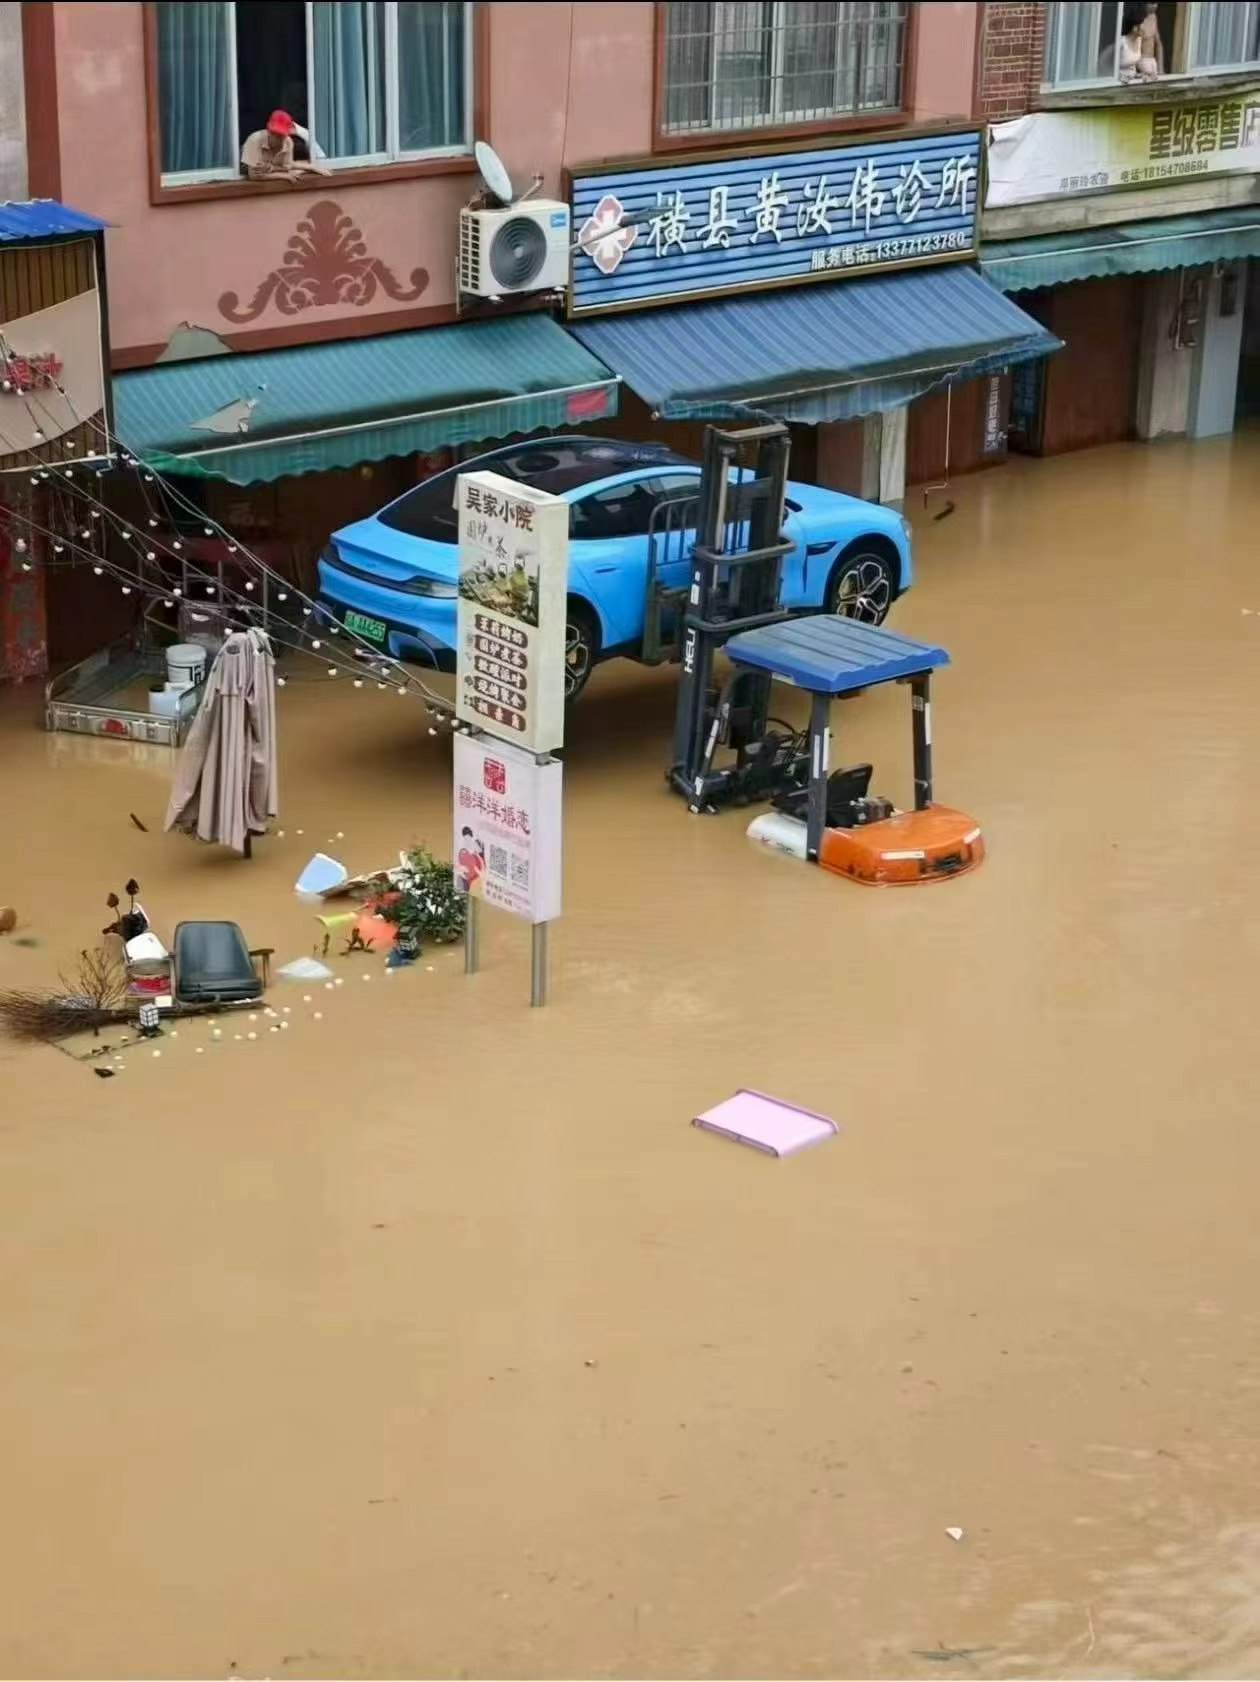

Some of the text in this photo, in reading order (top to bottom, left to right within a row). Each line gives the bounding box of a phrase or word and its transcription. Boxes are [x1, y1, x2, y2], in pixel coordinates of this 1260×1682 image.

[646, 154, 976, 257] 横县黄汝伟诊所
[466, 486, 534, 532] 吴家小院
